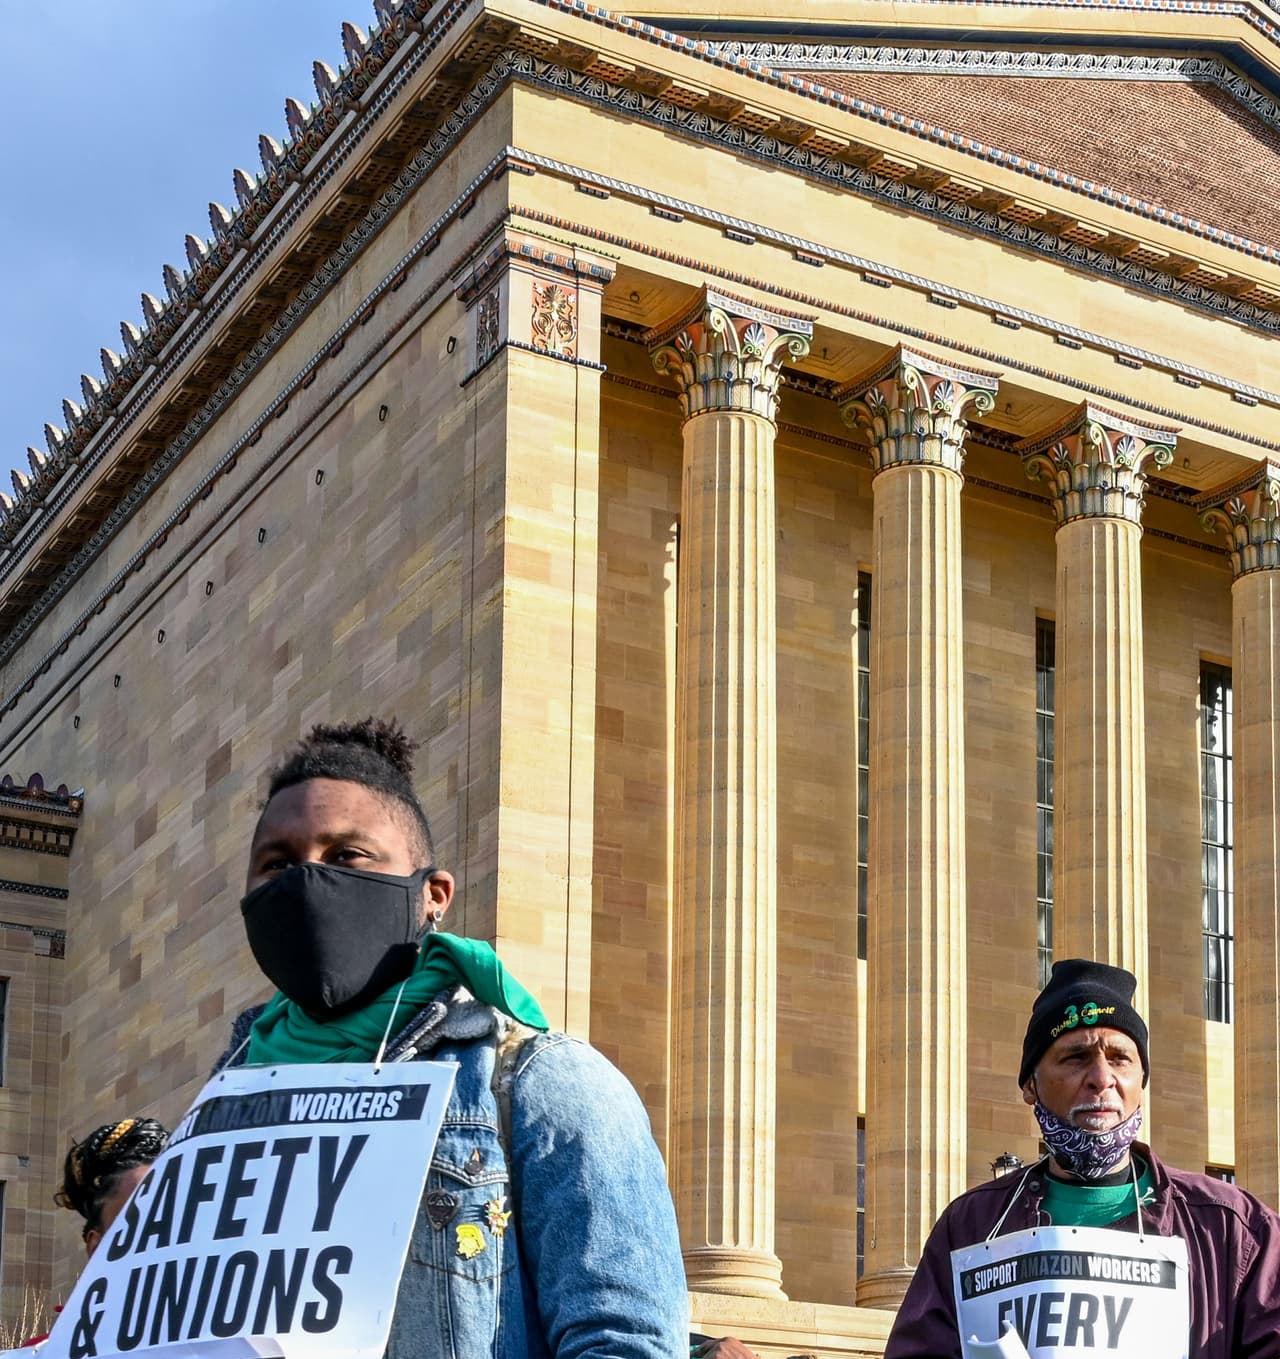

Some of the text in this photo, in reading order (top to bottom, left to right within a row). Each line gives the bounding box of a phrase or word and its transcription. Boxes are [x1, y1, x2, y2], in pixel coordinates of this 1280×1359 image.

[288, 1090, 404, 1122] WORKERS
[107, 1134, 370, 1262] SAFETY
[116, 1245, 354, 1352] UNIONS
[974, 1255, 1162, 1292] SUPPORT AMAZON WORKERS
